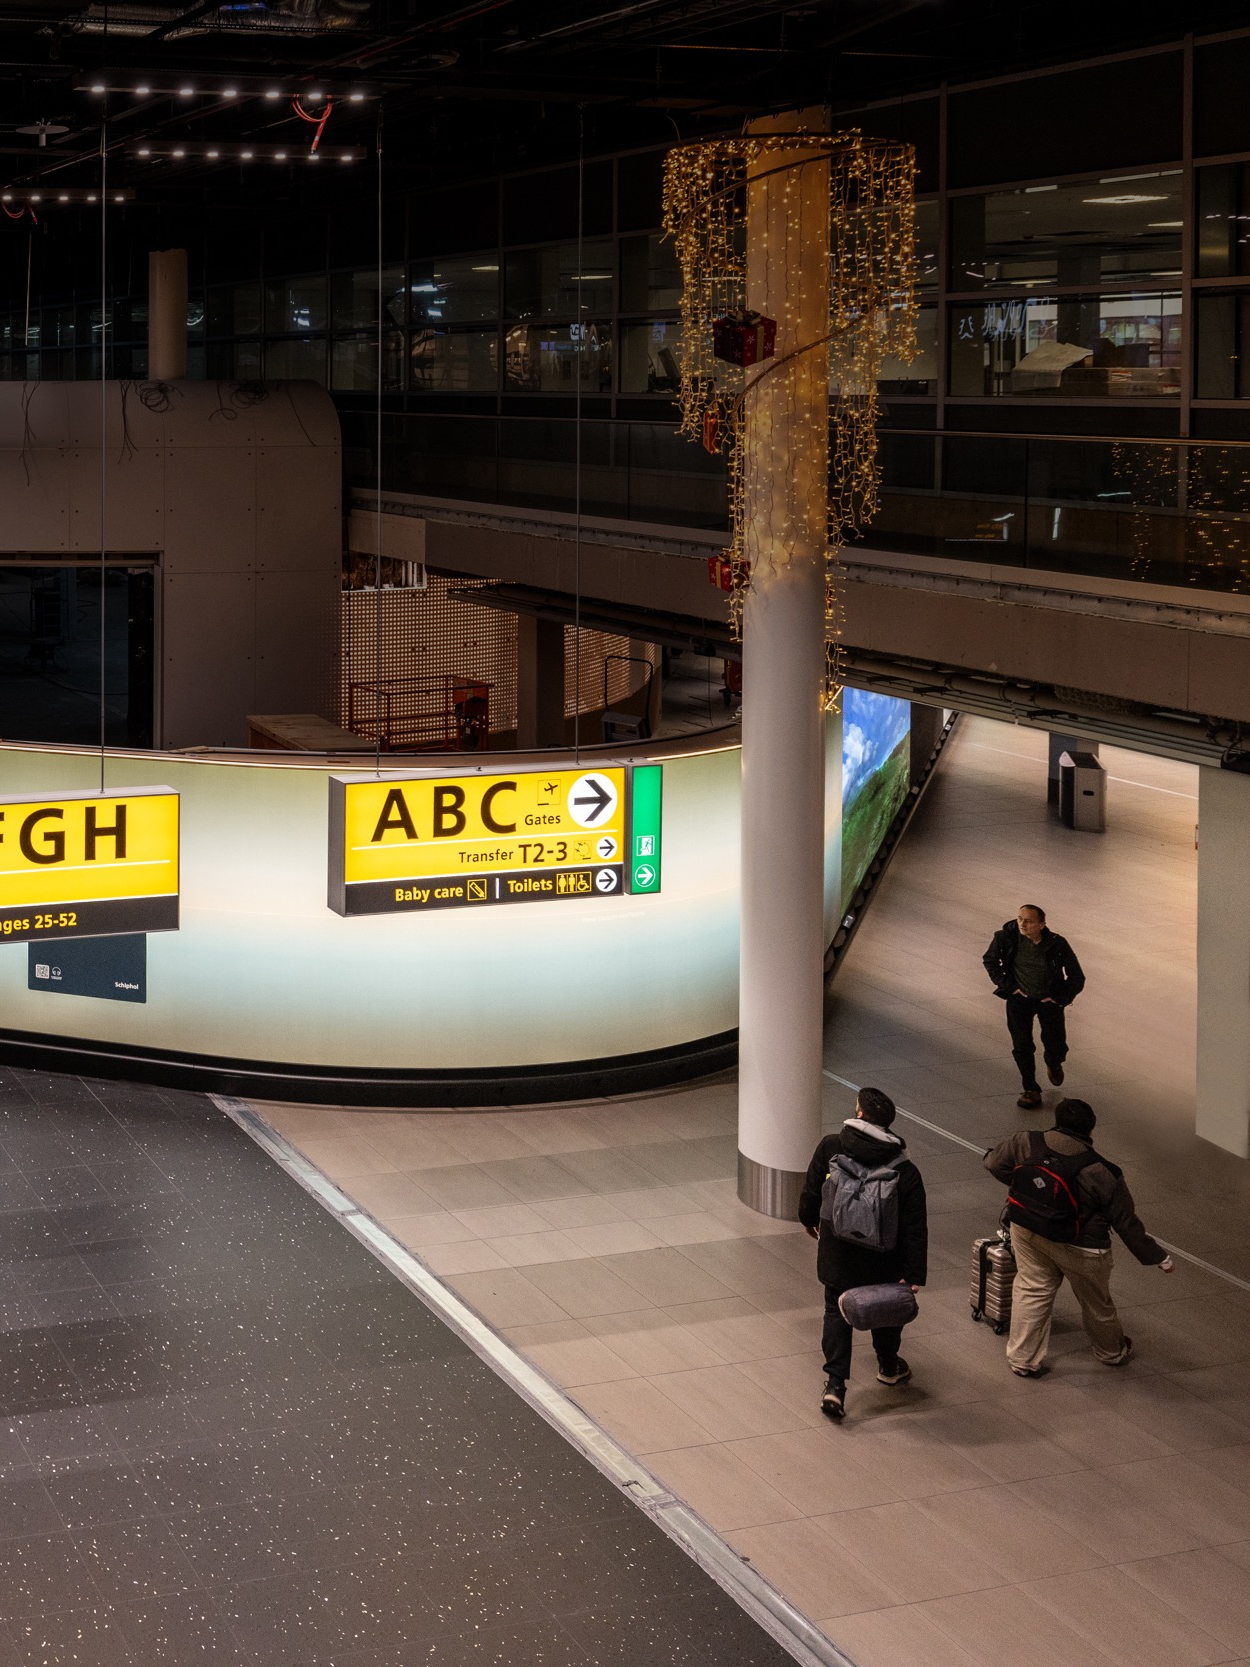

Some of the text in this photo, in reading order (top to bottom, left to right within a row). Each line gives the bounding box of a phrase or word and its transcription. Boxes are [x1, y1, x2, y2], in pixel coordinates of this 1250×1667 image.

[524, 813, 561, 826] Gates
[458, 841, 568, 864] Transfer T2-3
[507, 878, 553, 893] Toilets
[395, 886, 464, 903] Baby care
[34, 912, 78, 929] 25-52
[114, 981, 139, 990] Schiphol
